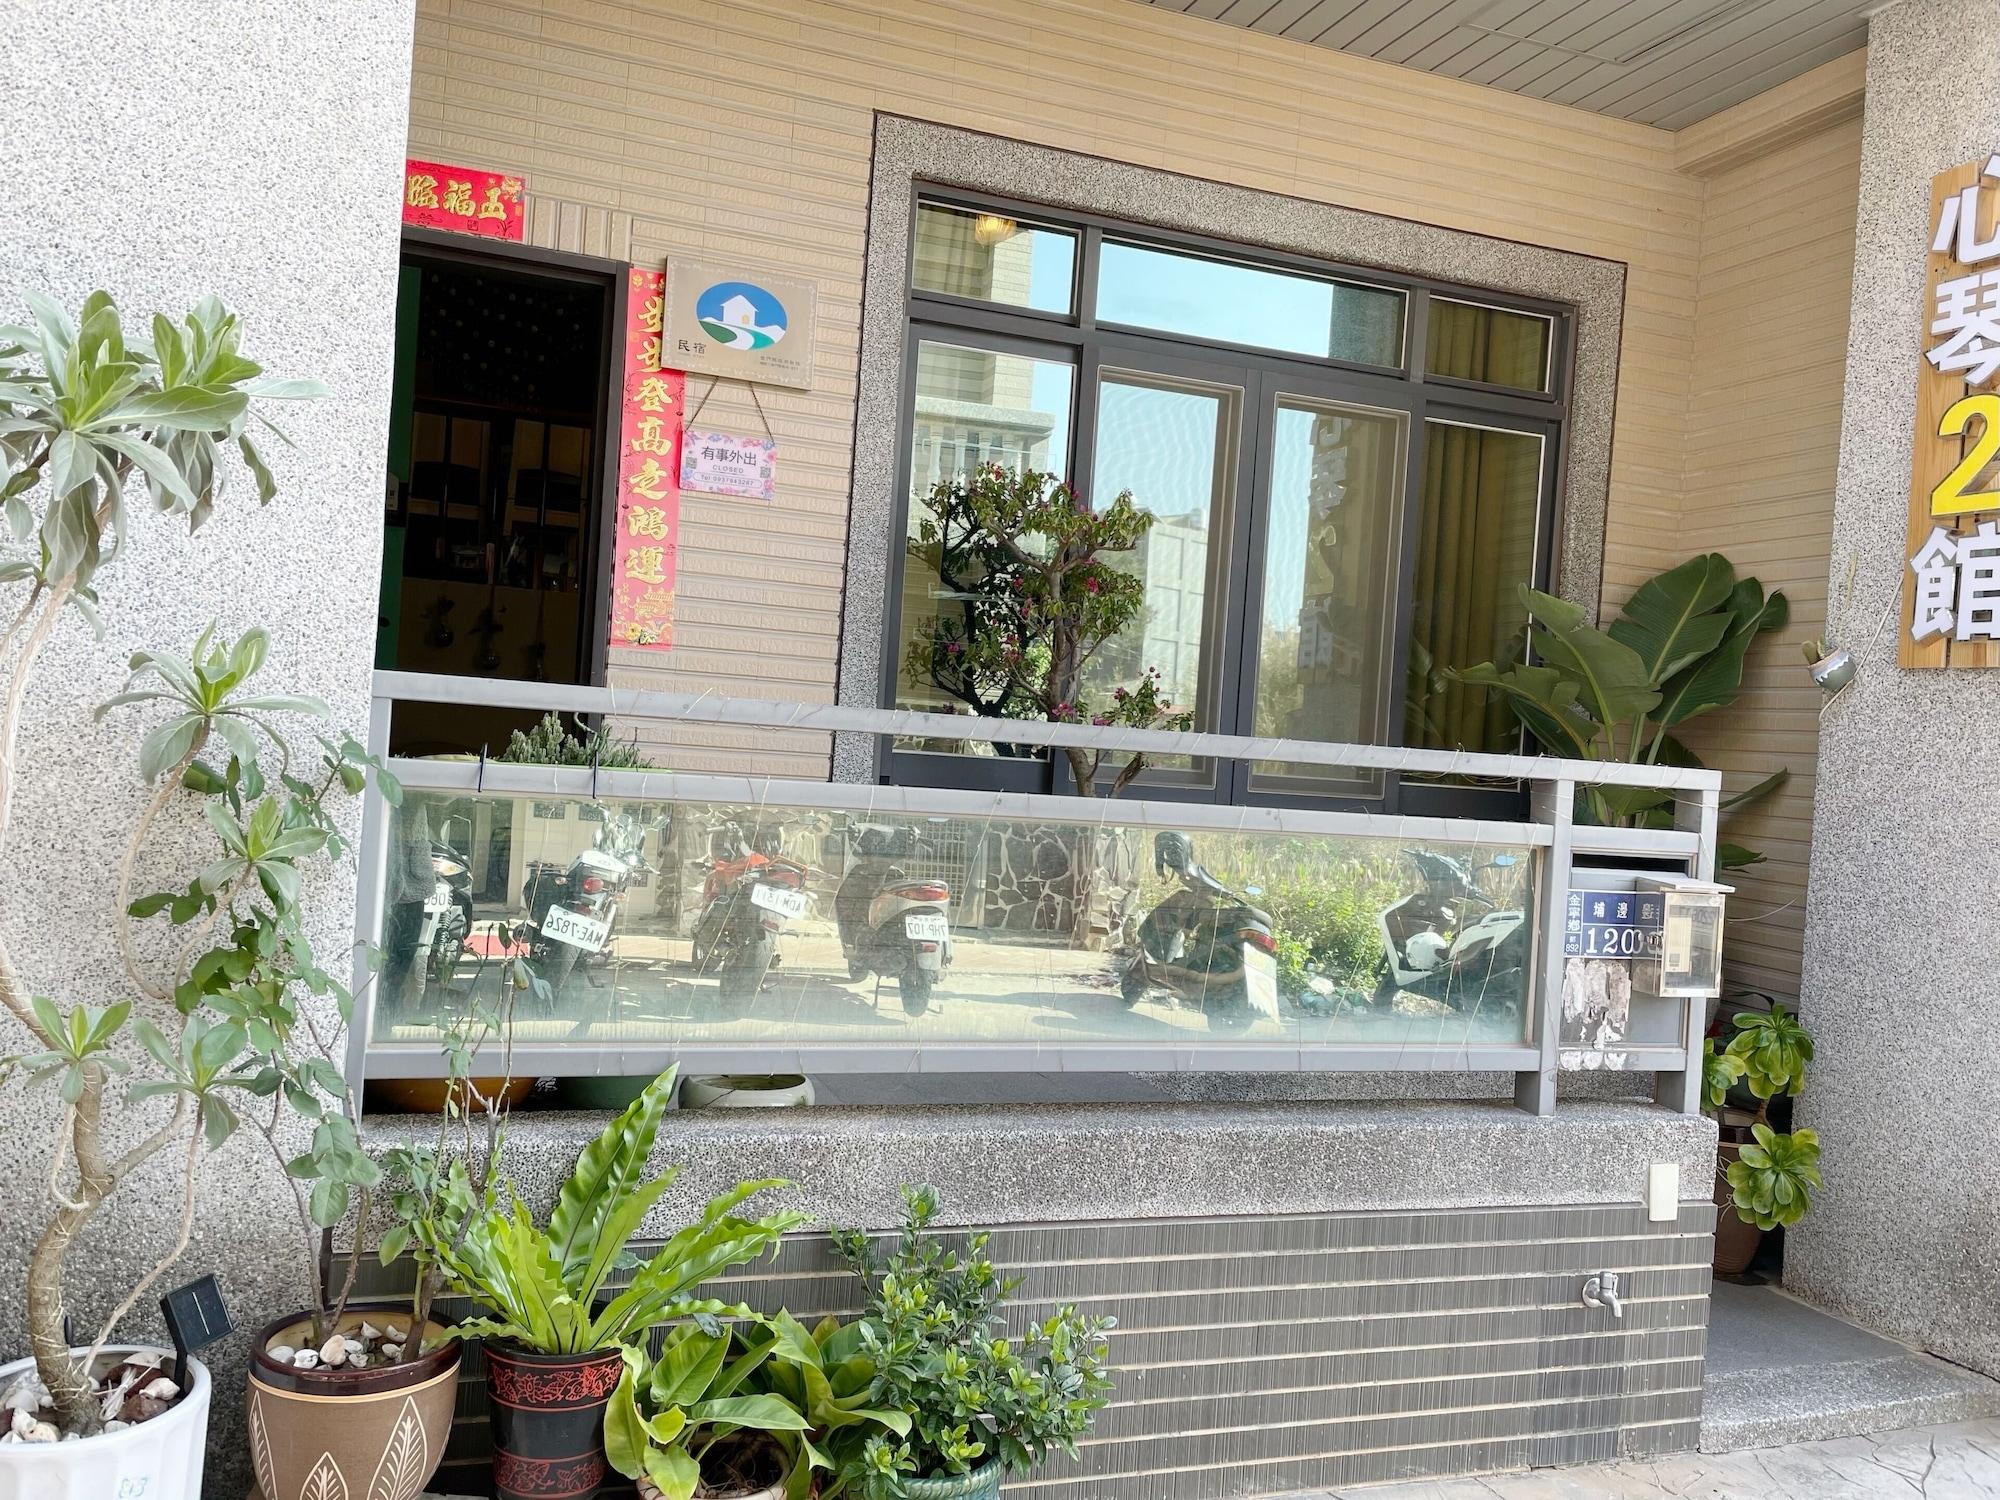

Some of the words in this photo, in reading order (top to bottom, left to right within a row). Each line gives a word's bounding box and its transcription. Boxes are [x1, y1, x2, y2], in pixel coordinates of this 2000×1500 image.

[678, 339, 707, 355] 民宿
[1910, 153, 2000, 642] 心琴2館
[701, 446, 757, 466] 有事外出
[712, 464, 744, 474] CLOSED
[1567, 893, 1581, 931] 金寧鄉
[1593, 901, 1628, 919] 埔邊
[1565, 943, 1580, 953] 892
[1586, 927, 1635, 955] 120
